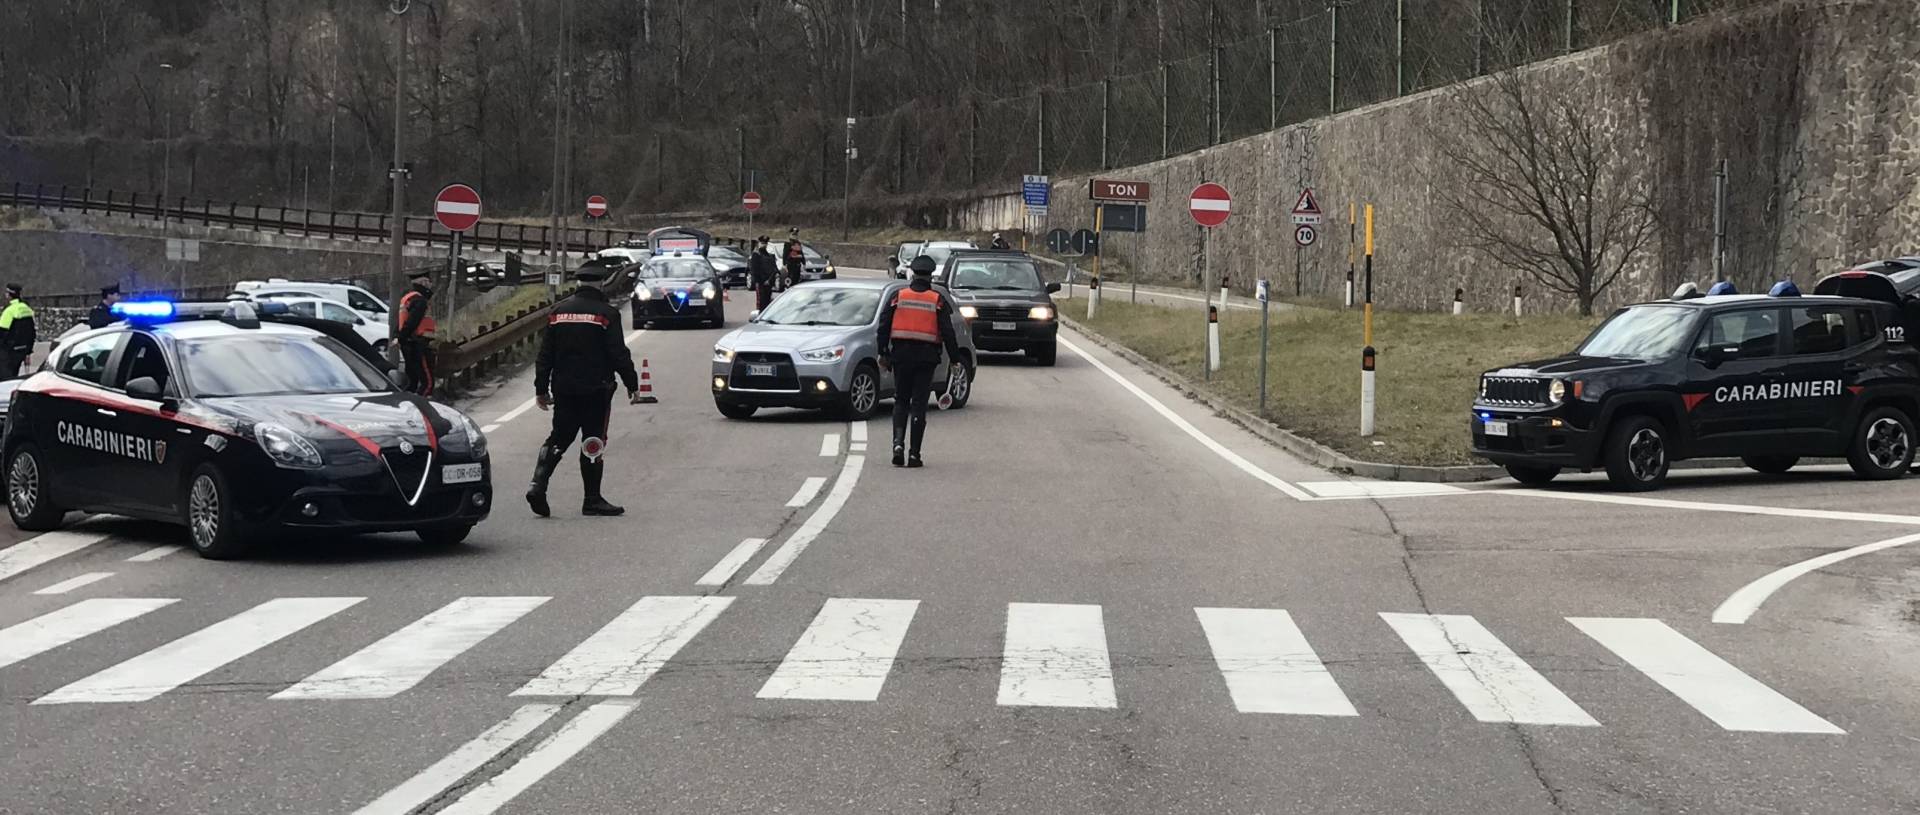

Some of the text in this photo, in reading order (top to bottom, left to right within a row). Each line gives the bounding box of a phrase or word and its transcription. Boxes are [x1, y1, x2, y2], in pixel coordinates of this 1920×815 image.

[1107, 183, 1137, 197] TON
[1300, 230, 1312, 241] 70
[1884, 326, 1905, 339] 112
[1715, 379, 1843, 403] CARABINIERI
[57, 420, 153, 462] CARABINIERI
